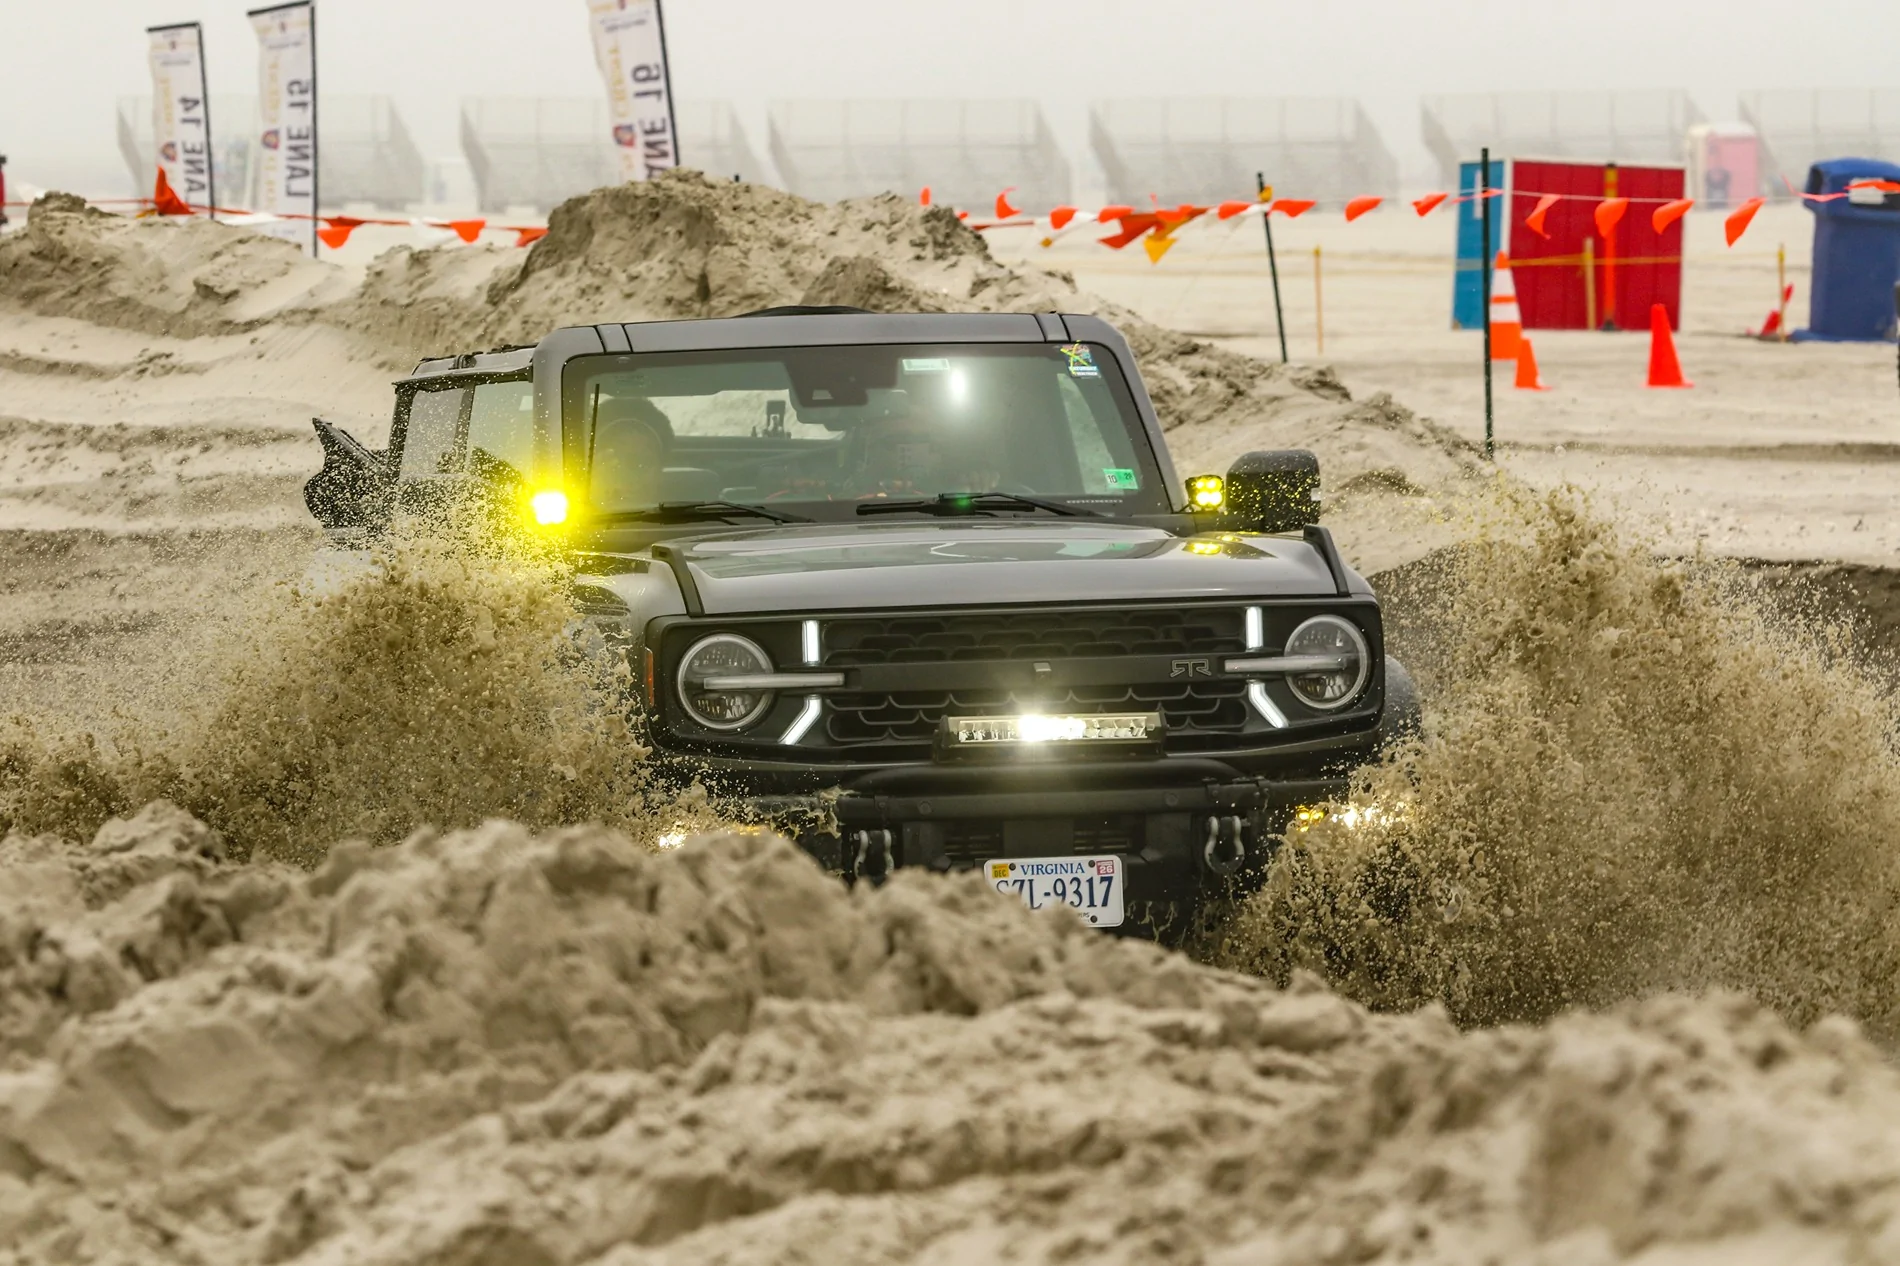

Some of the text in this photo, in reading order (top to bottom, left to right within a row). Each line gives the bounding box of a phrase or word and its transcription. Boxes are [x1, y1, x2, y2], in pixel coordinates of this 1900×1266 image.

[1107, 474, 1118, 484] 10
[1170, 658, 1212, 678] RTR
[993, 869, 1007, 878] DEC
[1020, 862, 1086, 876] VIRGINIA
[1099, 864, 1114, 874] 26
